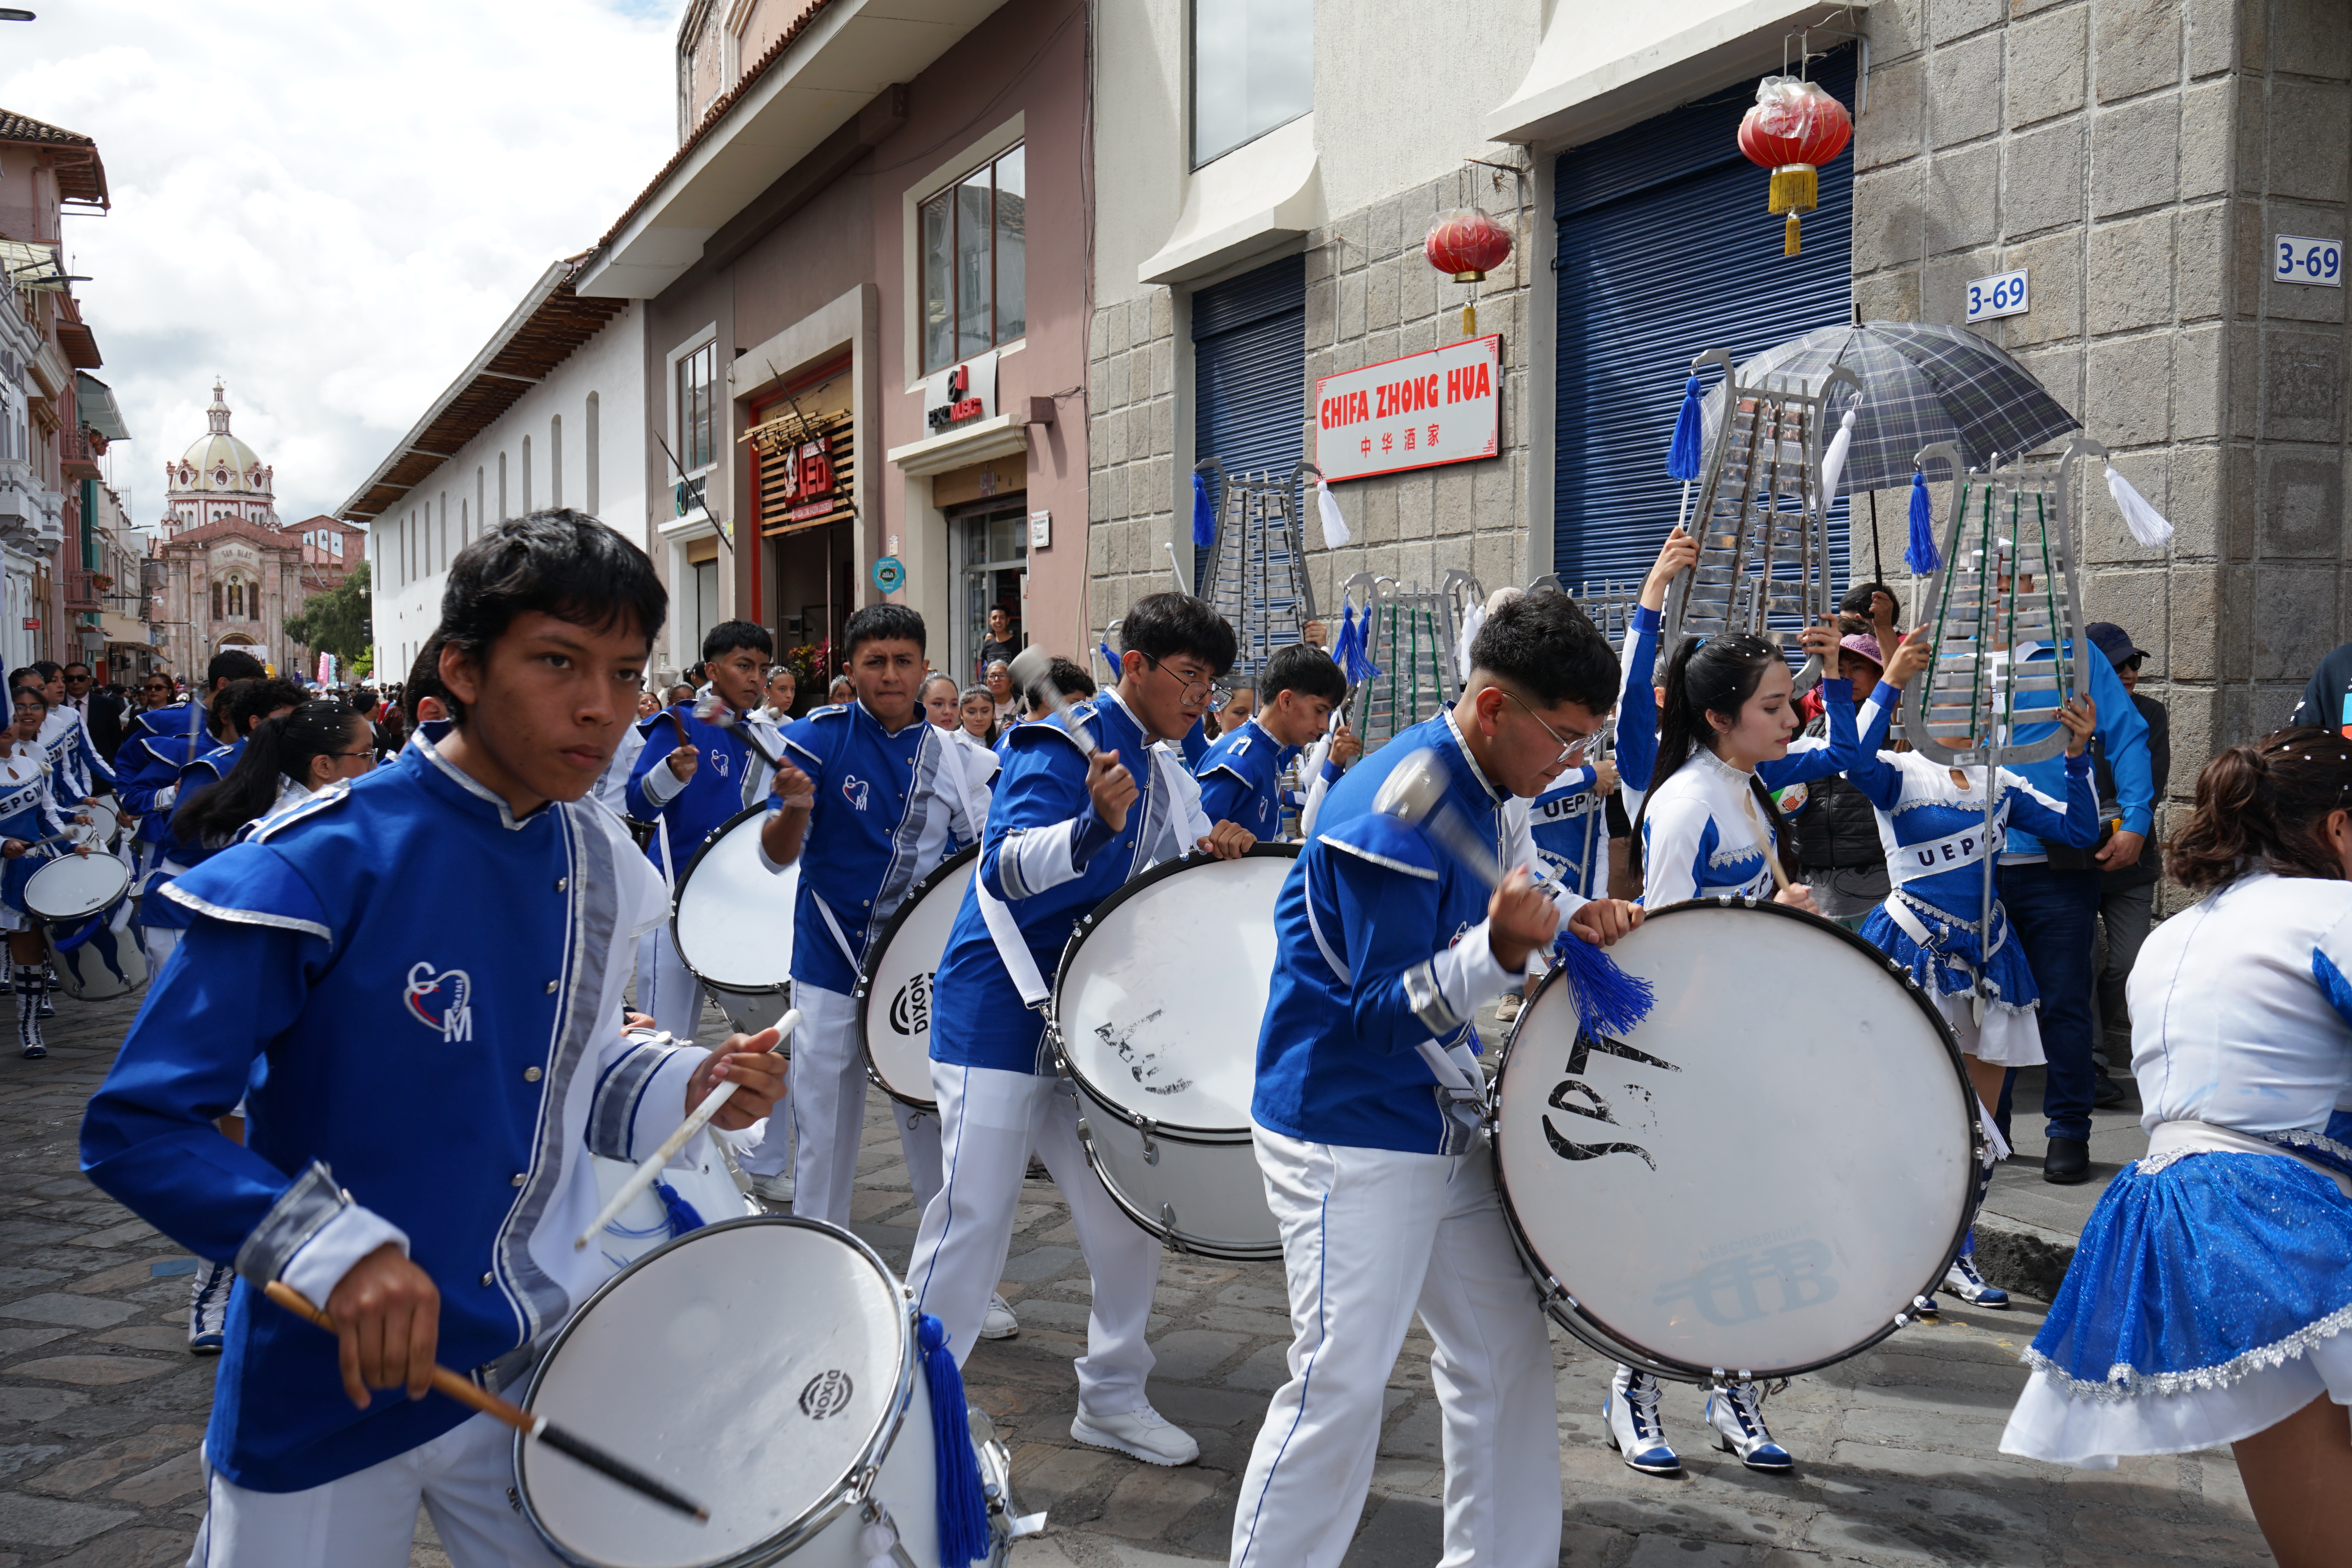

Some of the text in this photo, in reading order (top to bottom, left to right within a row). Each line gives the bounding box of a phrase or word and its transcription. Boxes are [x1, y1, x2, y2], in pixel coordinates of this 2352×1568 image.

[2278, 242, 2339, 278] 3-69
[1969, 277, 2025, 315] 3-69
[1321, 363, 1490, 430] CHIFA ZHONG HUA
[1361, 423, 1439, 458] 中华酒家
[222, 550, 252, 559] SAN BLAS
[910, 973, 928, 1035] DIXON
[444, 1006, 472, 1043] M
[812, 1370, 841, 1420] DIXON
